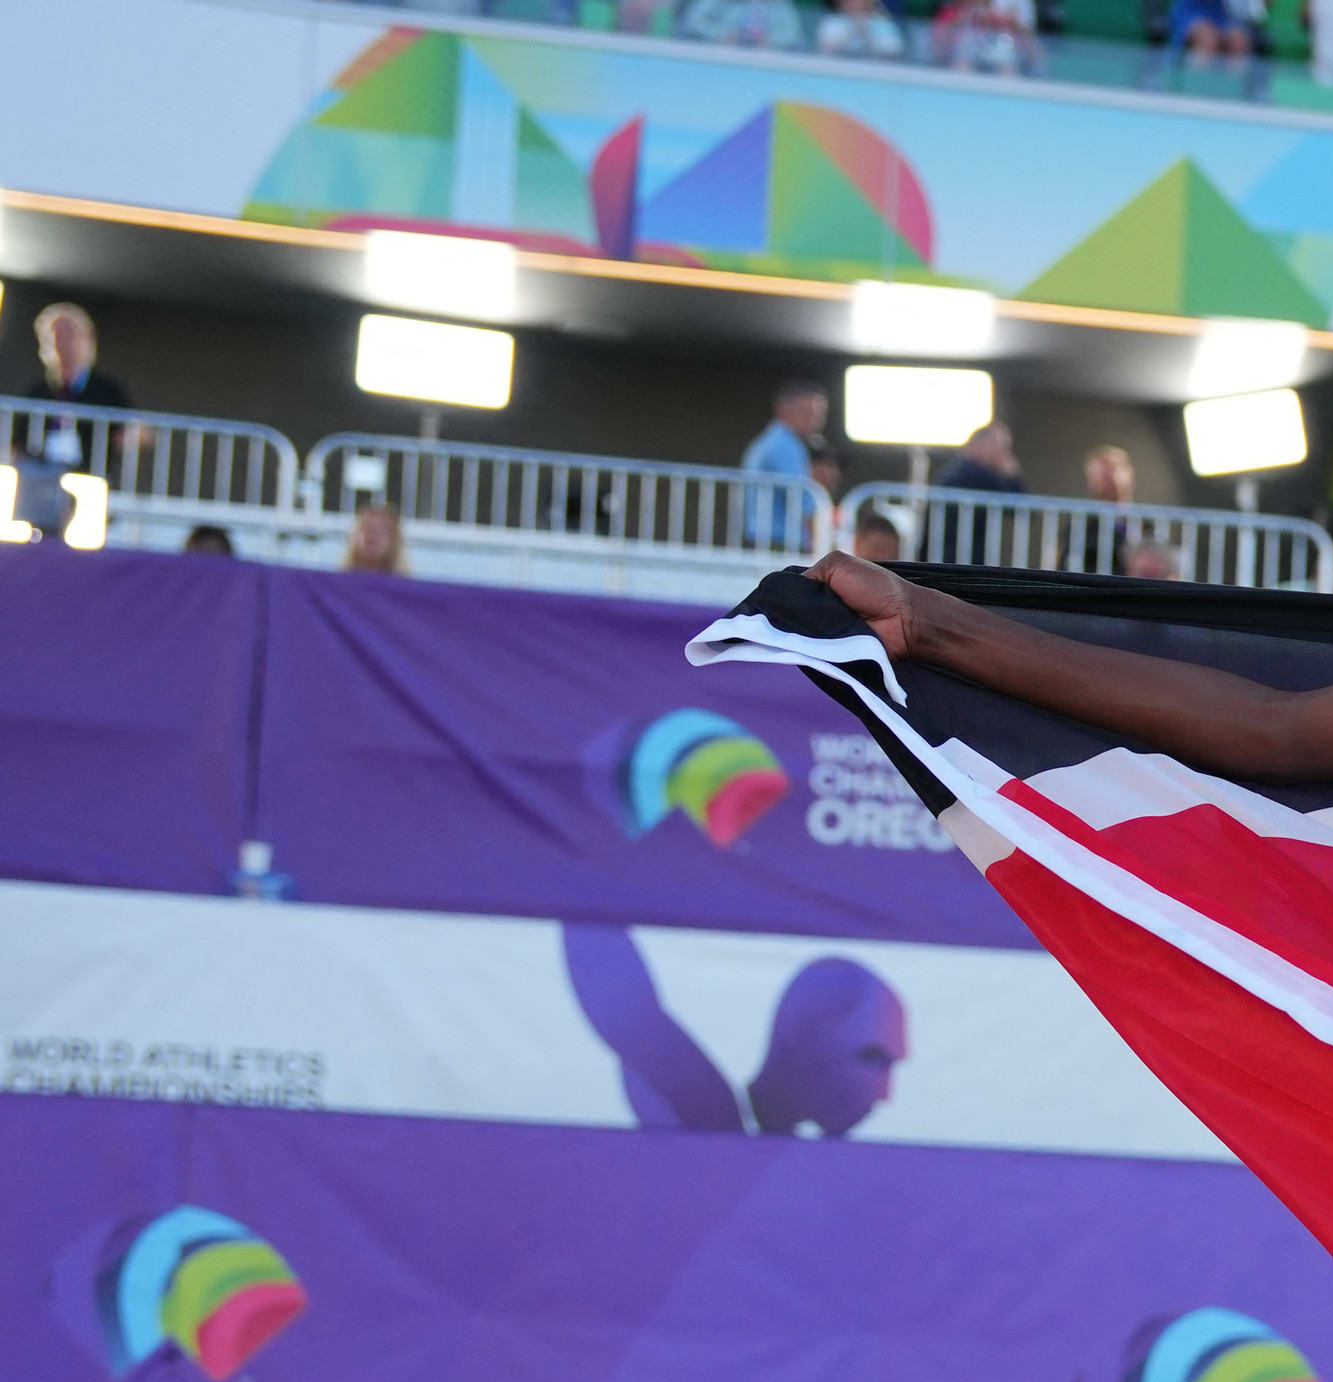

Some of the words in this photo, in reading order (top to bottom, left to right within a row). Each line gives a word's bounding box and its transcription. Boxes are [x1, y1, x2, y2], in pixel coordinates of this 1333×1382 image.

[807, 797, 956, 853] OREG
[9, 1038, 133, 1066] WORLD
[141, 1041, 328, 1078] ATHLETICS
[4, 1066, 328, 1110] CHAMPIONSHIPS
